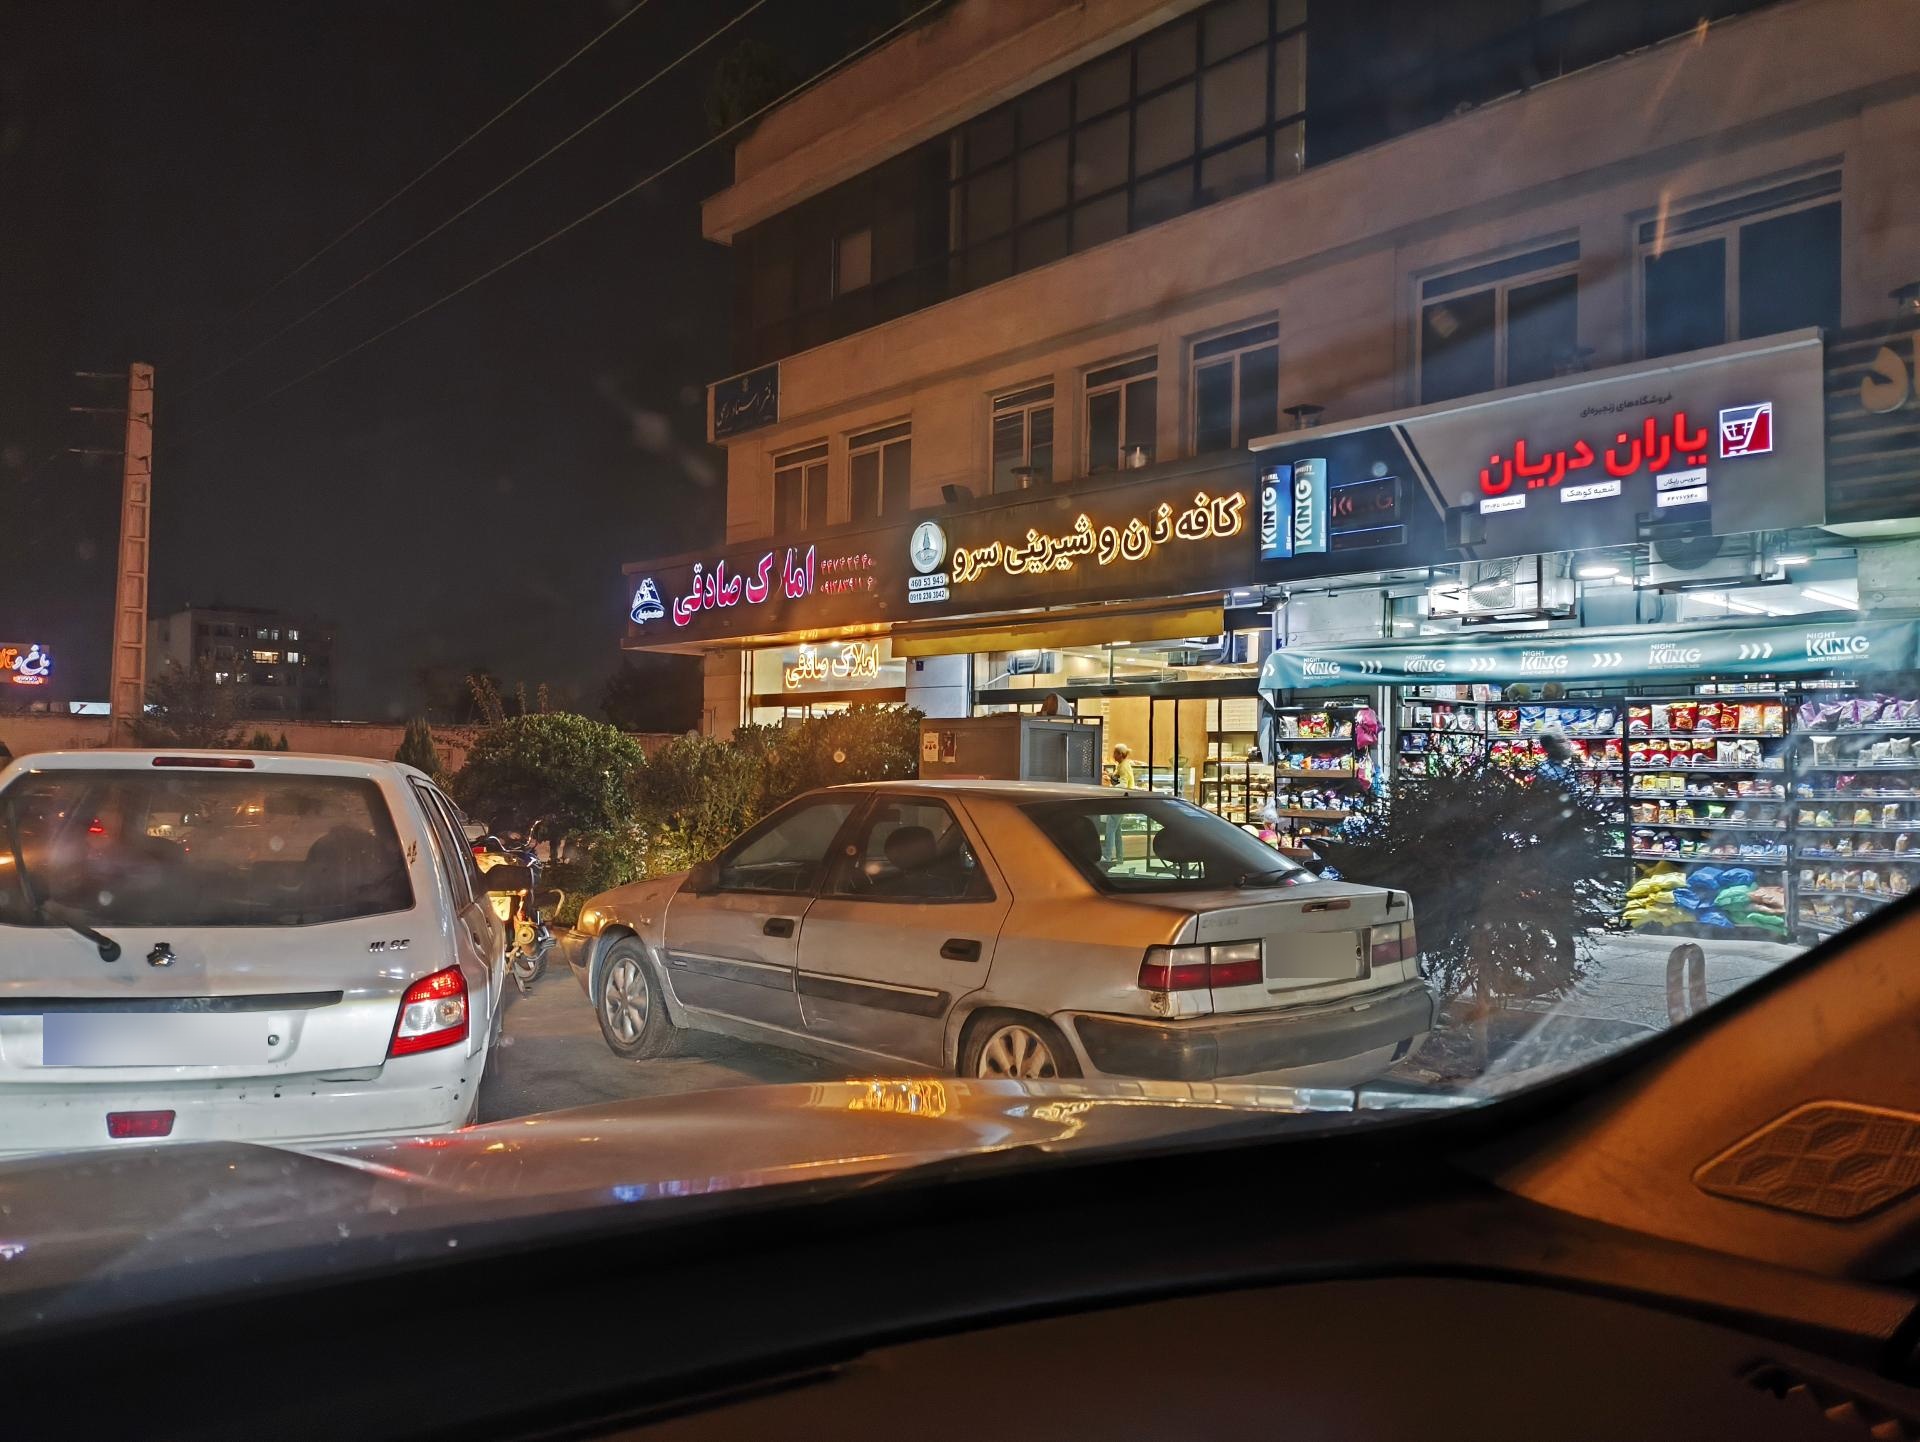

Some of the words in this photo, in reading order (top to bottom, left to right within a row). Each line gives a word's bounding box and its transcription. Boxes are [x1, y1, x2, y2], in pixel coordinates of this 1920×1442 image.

[1604, 412, 1709, 477] یاران
[1479, 439, 1595, 495] دریان
[1593, 484, 1615, 494] شعبه
[1121, 502, 1173, 561] نان
[1175, 491, 1247, 540] کافه
[1261, 486, 1277, 551] KING
[1295, 479, 1313, 547] KING
[952, 541, 1003, 583] سرو
[1003, 513, 1097, 575] شیرینی
[1098, 525, 1121, 566] و
[672, 560, 742, 627] صادقی
[1806, 631, 1837, 639] NIGHT
[1806, 635, 1870, 657] KING
[785, 644, 829, 689] صادقی
[831, 642, 879, 679] املاک
[1302, 661, 1341, 675] KING
[1403, 659, 1446, 673] KING
[1519, 655, 1569, 671] KING
[1649, 648, 1702, 665] KING
